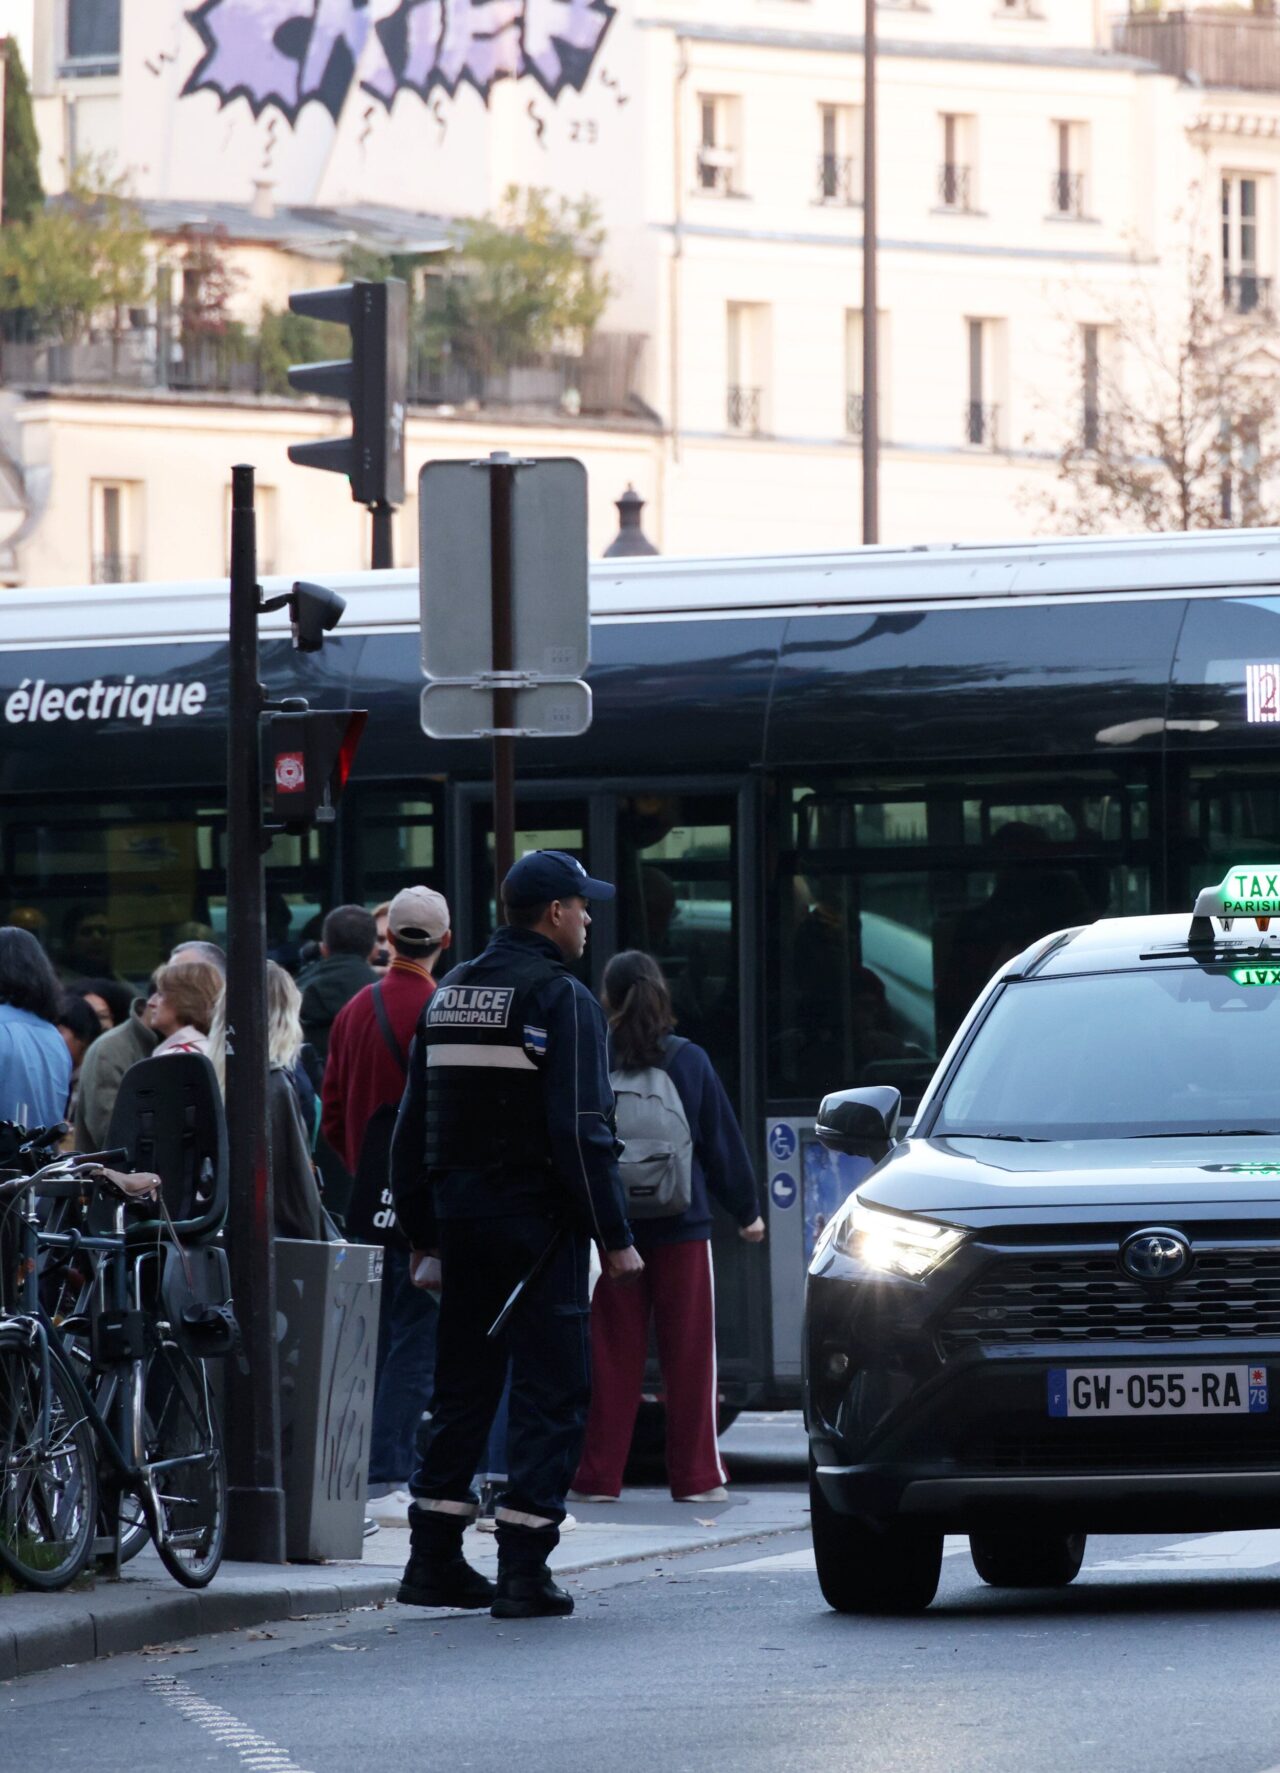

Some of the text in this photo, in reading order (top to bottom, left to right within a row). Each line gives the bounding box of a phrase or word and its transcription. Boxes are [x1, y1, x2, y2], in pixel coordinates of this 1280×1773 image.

[5, 675, 207, 726] électrique
[432, 989, 508, 1010] POLICE
[430, 1010, 503, 1024] MUNICIPALE
[1073, 1373, 1241, 1410] GW-055-RA
[1250, 1389, 1268, 1405] 78
